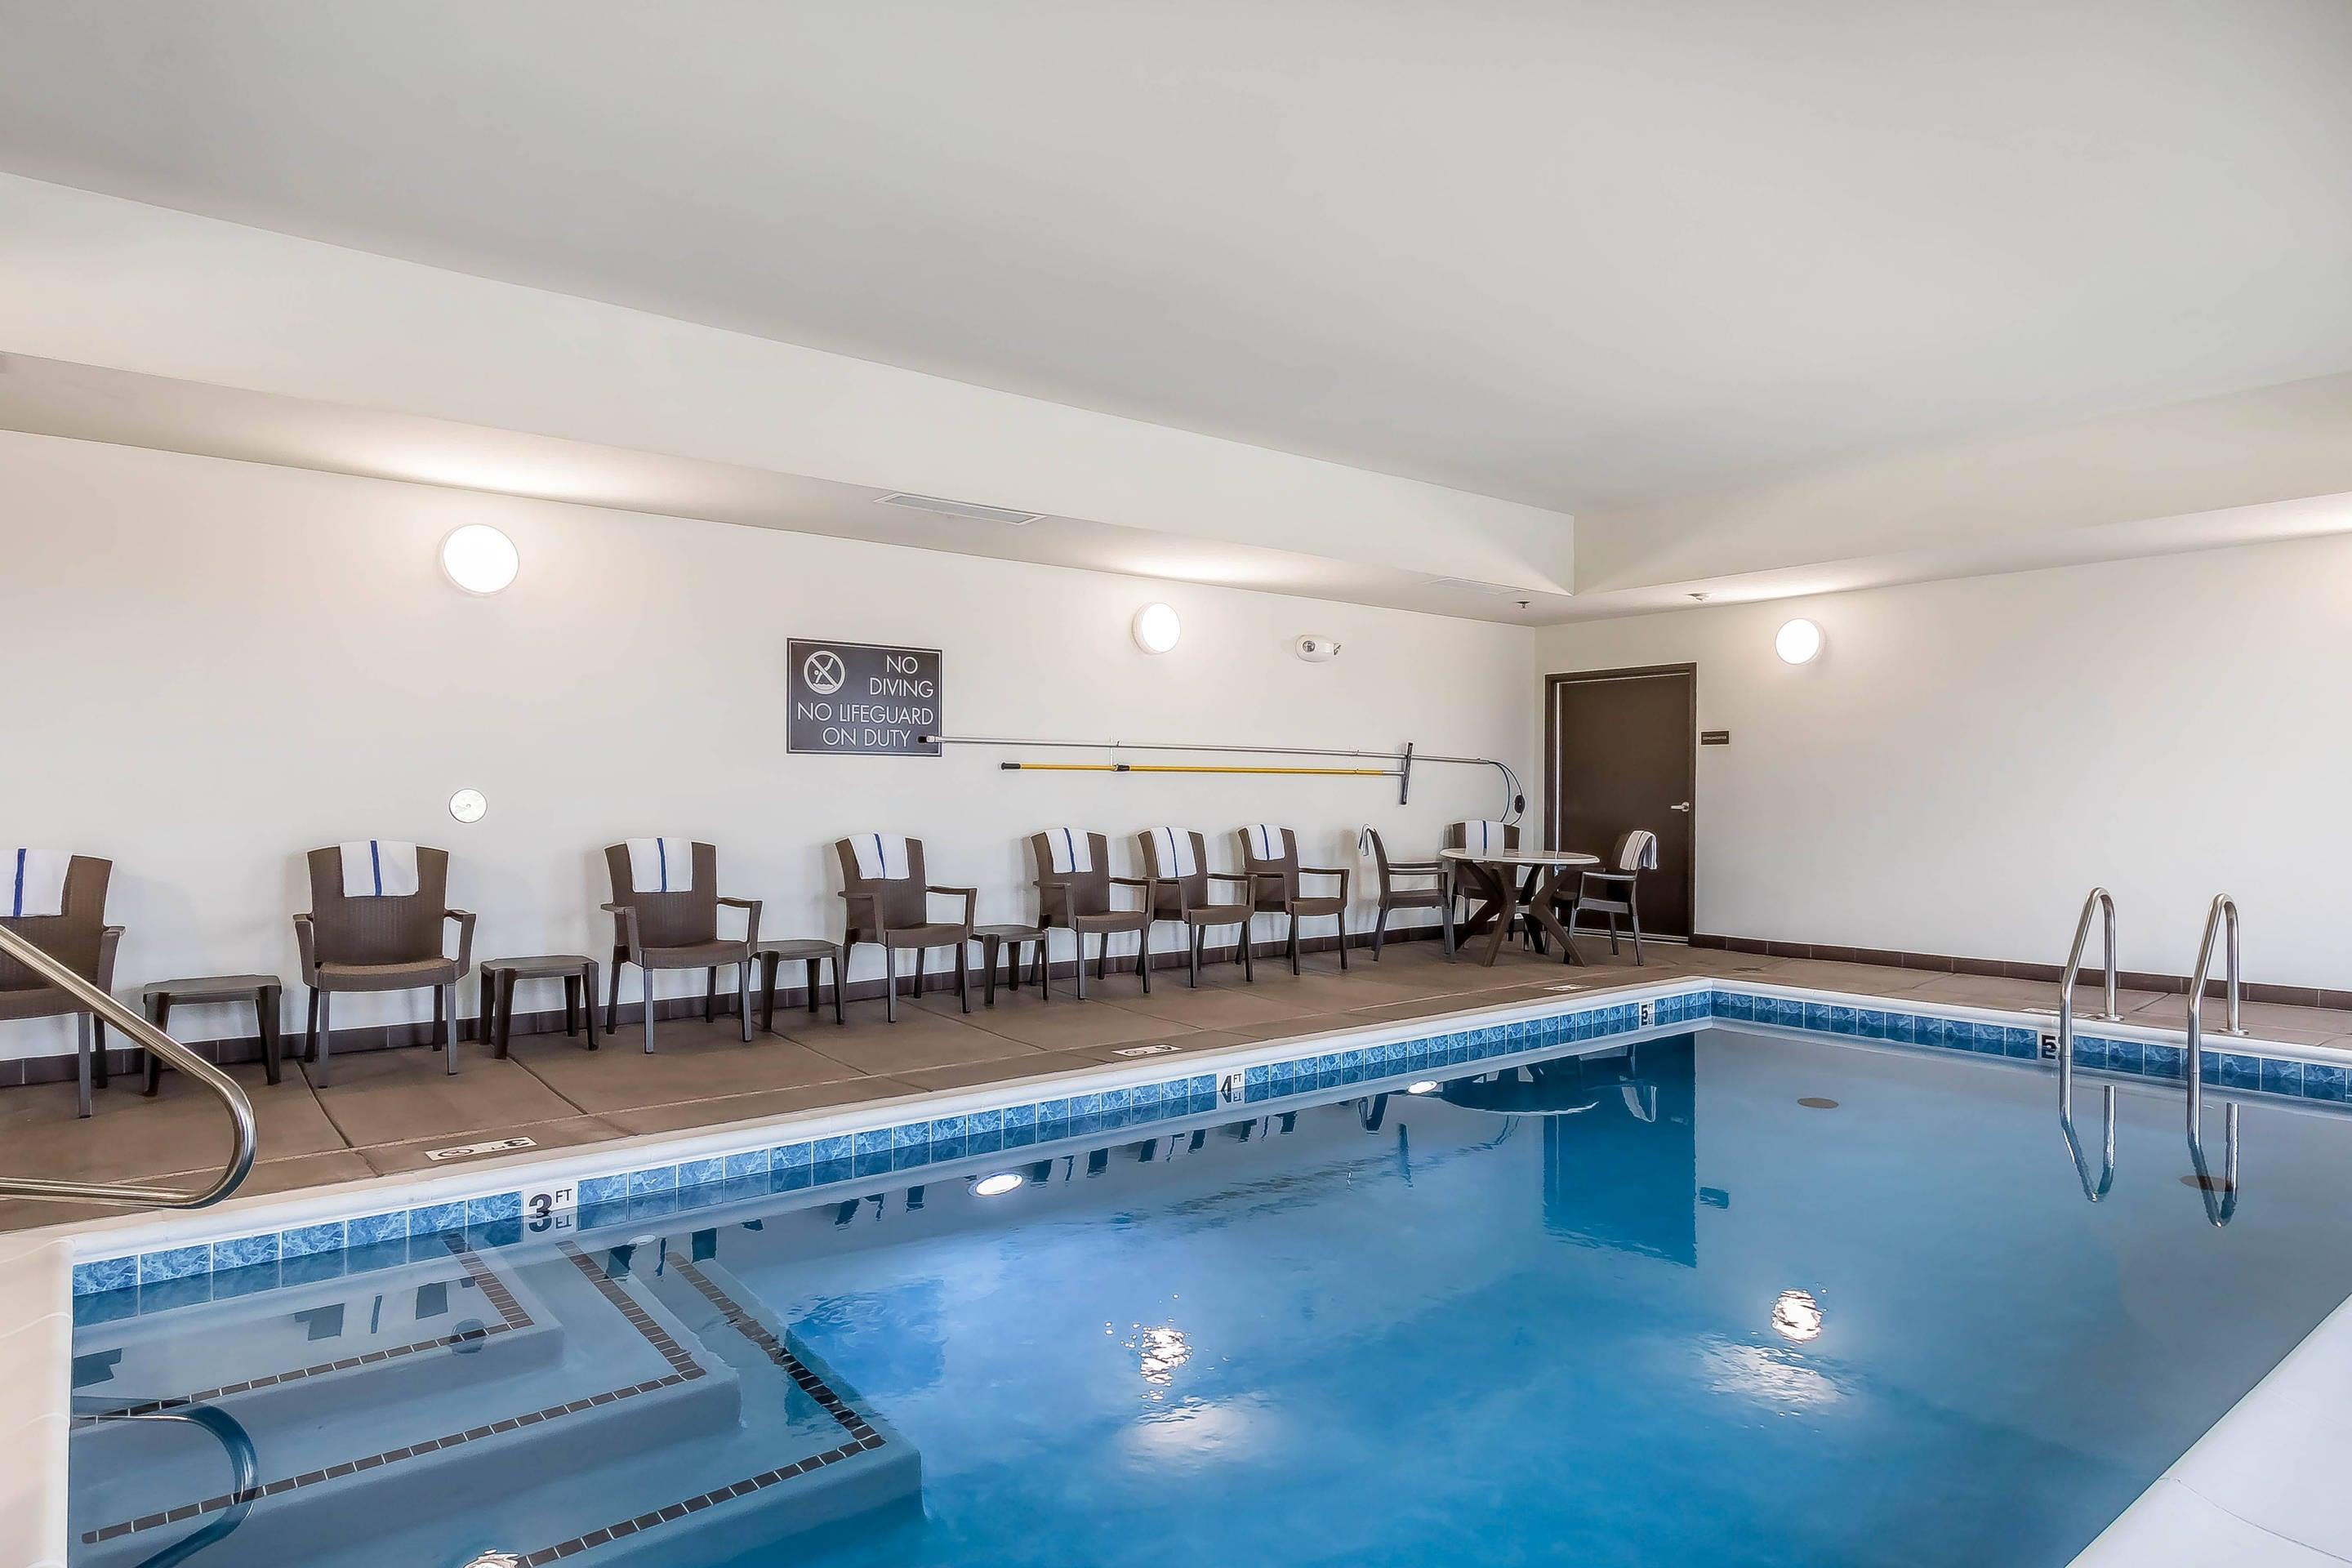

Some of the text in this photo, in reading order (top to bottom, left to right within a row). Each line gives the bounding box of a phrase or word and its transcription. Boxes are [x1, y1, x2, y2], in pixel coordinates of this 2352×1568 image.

[886, 654, 919, 675] NO
[870, 677, 934, 698] DIVING
[797, 702, 933, 725] NO LIFEGUARD
[822, 727, 911, 747] ON DUTY
[1641, 1004, 1648, 1019] 5
[2042, 1034, 2057, 1053] 5
[1221, 1073, 1242, 1093] 4 FT
[528, 1188, 572, 1218] 3 FT
